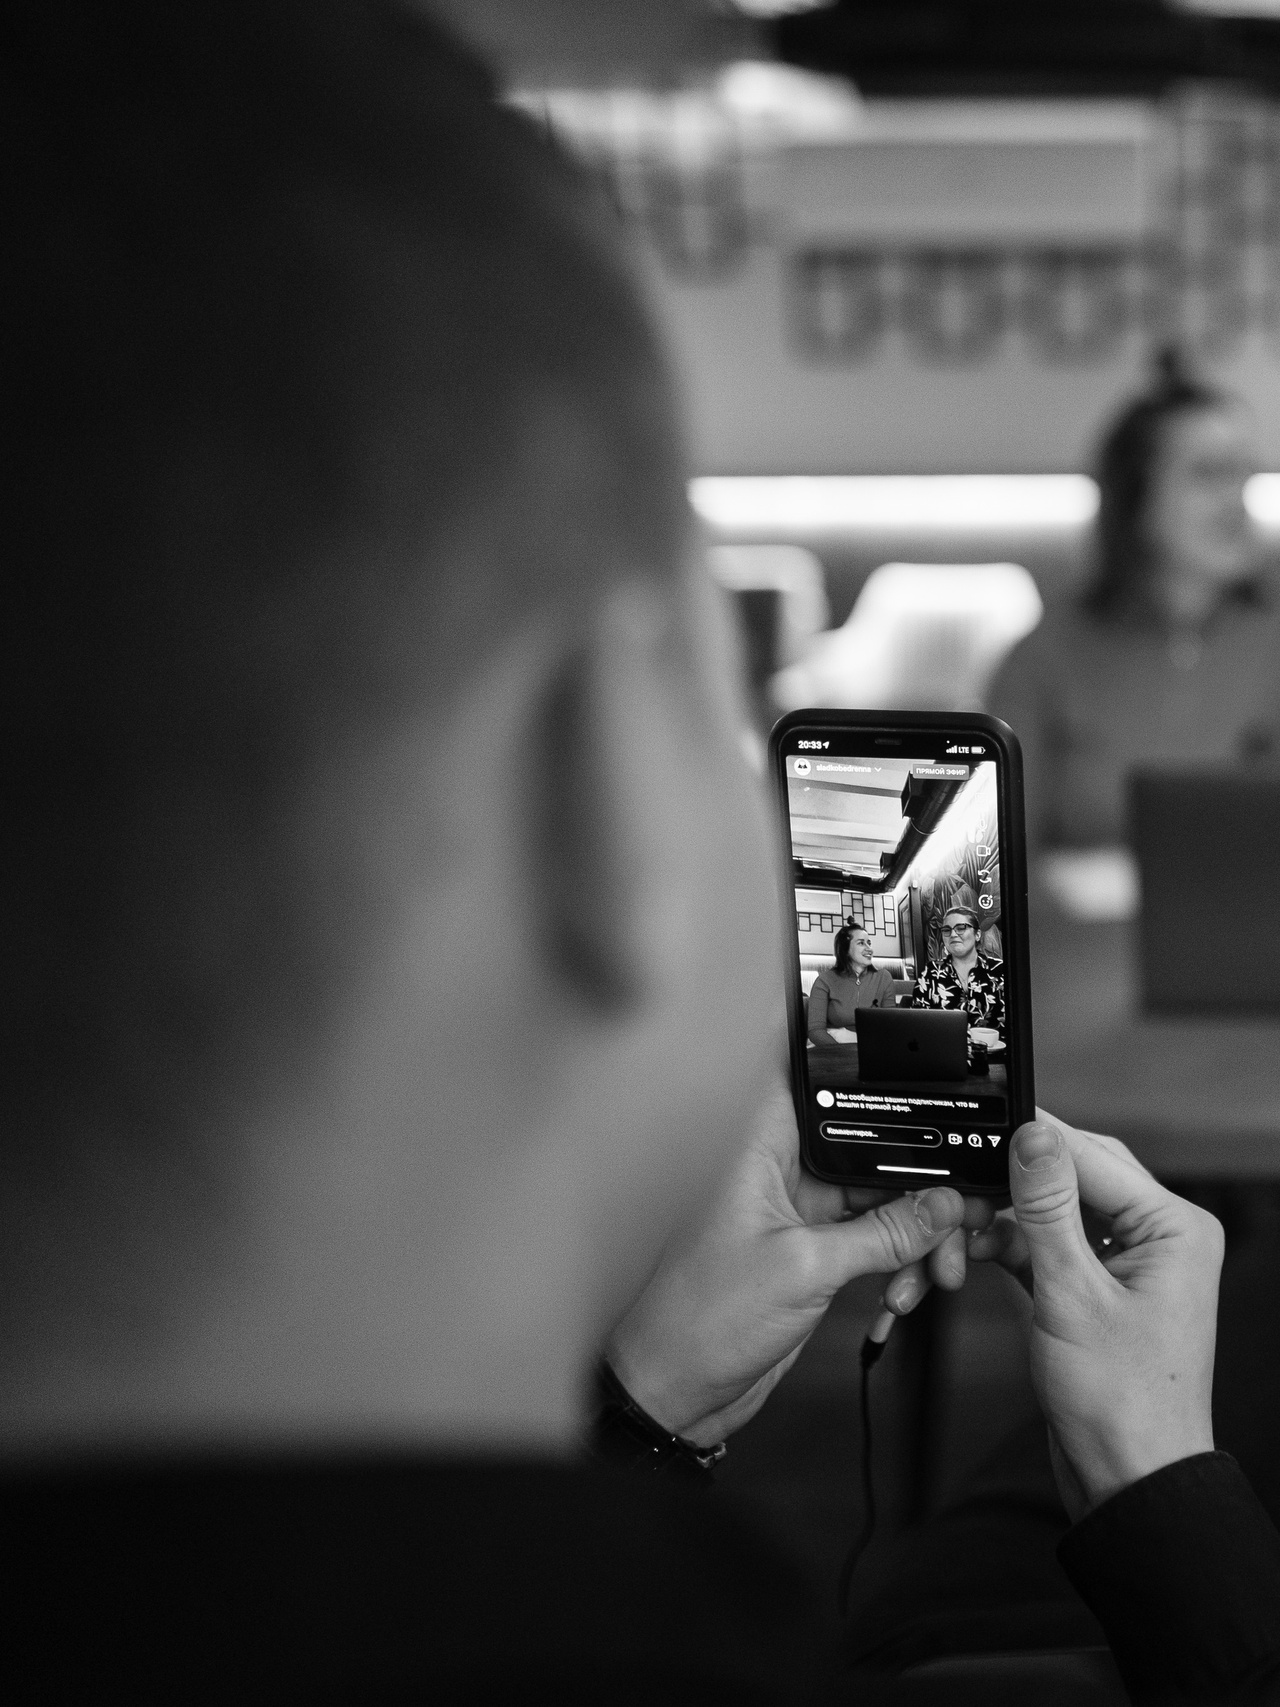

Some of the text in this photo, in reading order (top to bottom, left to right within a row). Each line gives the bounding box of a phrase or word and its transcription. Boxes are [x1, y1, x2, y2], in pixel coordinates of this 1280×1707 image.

[798, 740, 822, 749] 20:33
[958, 746, 969, 754] LTE
[916, 767, 966, 776] ПРЯМОЙ ЭФИР
